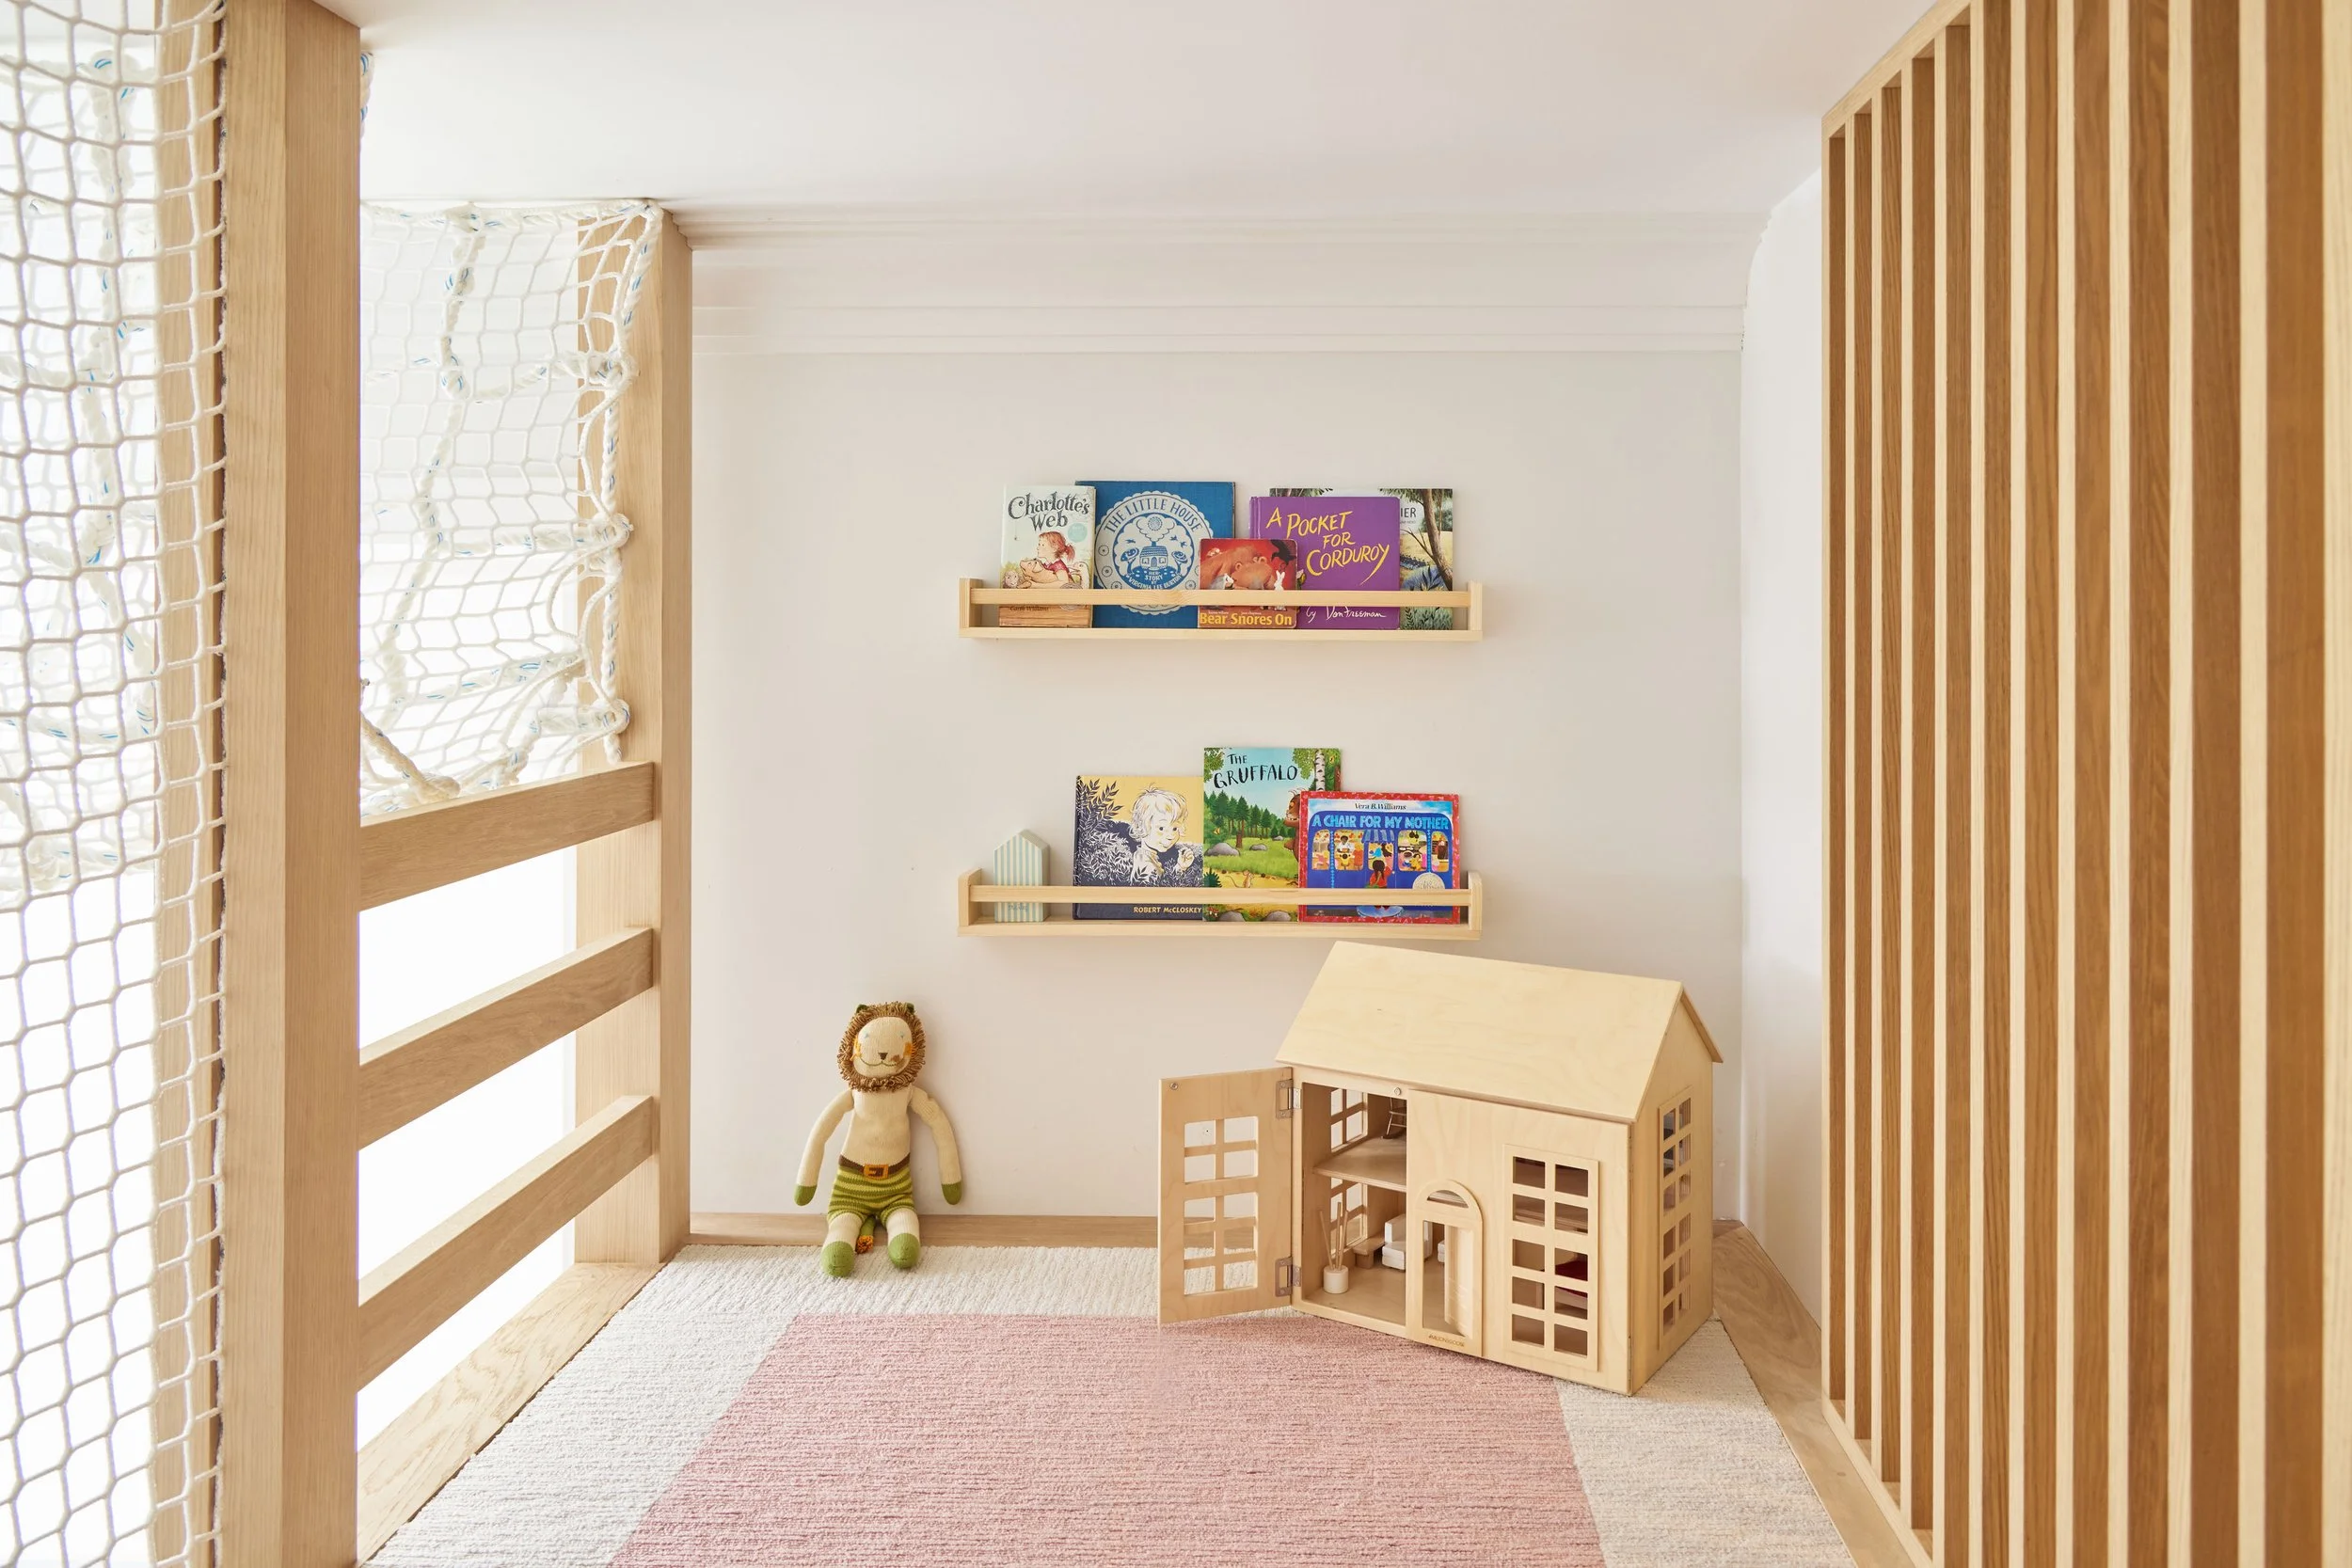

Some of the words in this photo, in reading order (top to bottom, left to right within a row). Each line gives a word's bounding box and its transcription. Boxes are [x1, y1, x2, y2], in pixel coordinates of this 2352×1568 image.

[1008, 491, 1089, 519] Charlotte's
[1104, 509, 1127, 533] THE
[1124, 498, 1168, 516] LITTLE
[1169, 501, 1203, 533] HOUSE
[1400, 507, 1417, 518] IER
[1029, 510, 1069, 531] Web
[1265, 507, 1282, 529] A
[1285, 511, 1353, 539] POCKET
[1323, 531, 1356, 549] FOR
[1306, 543, 1390, 585] CORDUROY
[1200, 612, 1228, 625] Bear
[1231, 612, 1273, 626] Snores
[1275, 613, 1292, 626] On
[1227, 753, 1248, 765] THE
[1214, 764, 1298, 789] GRUFFALO
[1311, 815, 1322, 828] A
[1323, 815, 1357, 828] CHAIR
[1359, 816, 1382, 829] FOR
[1384, 816, 1402, 829] MY
[1405, 816, 1449, 830] MOTHER
